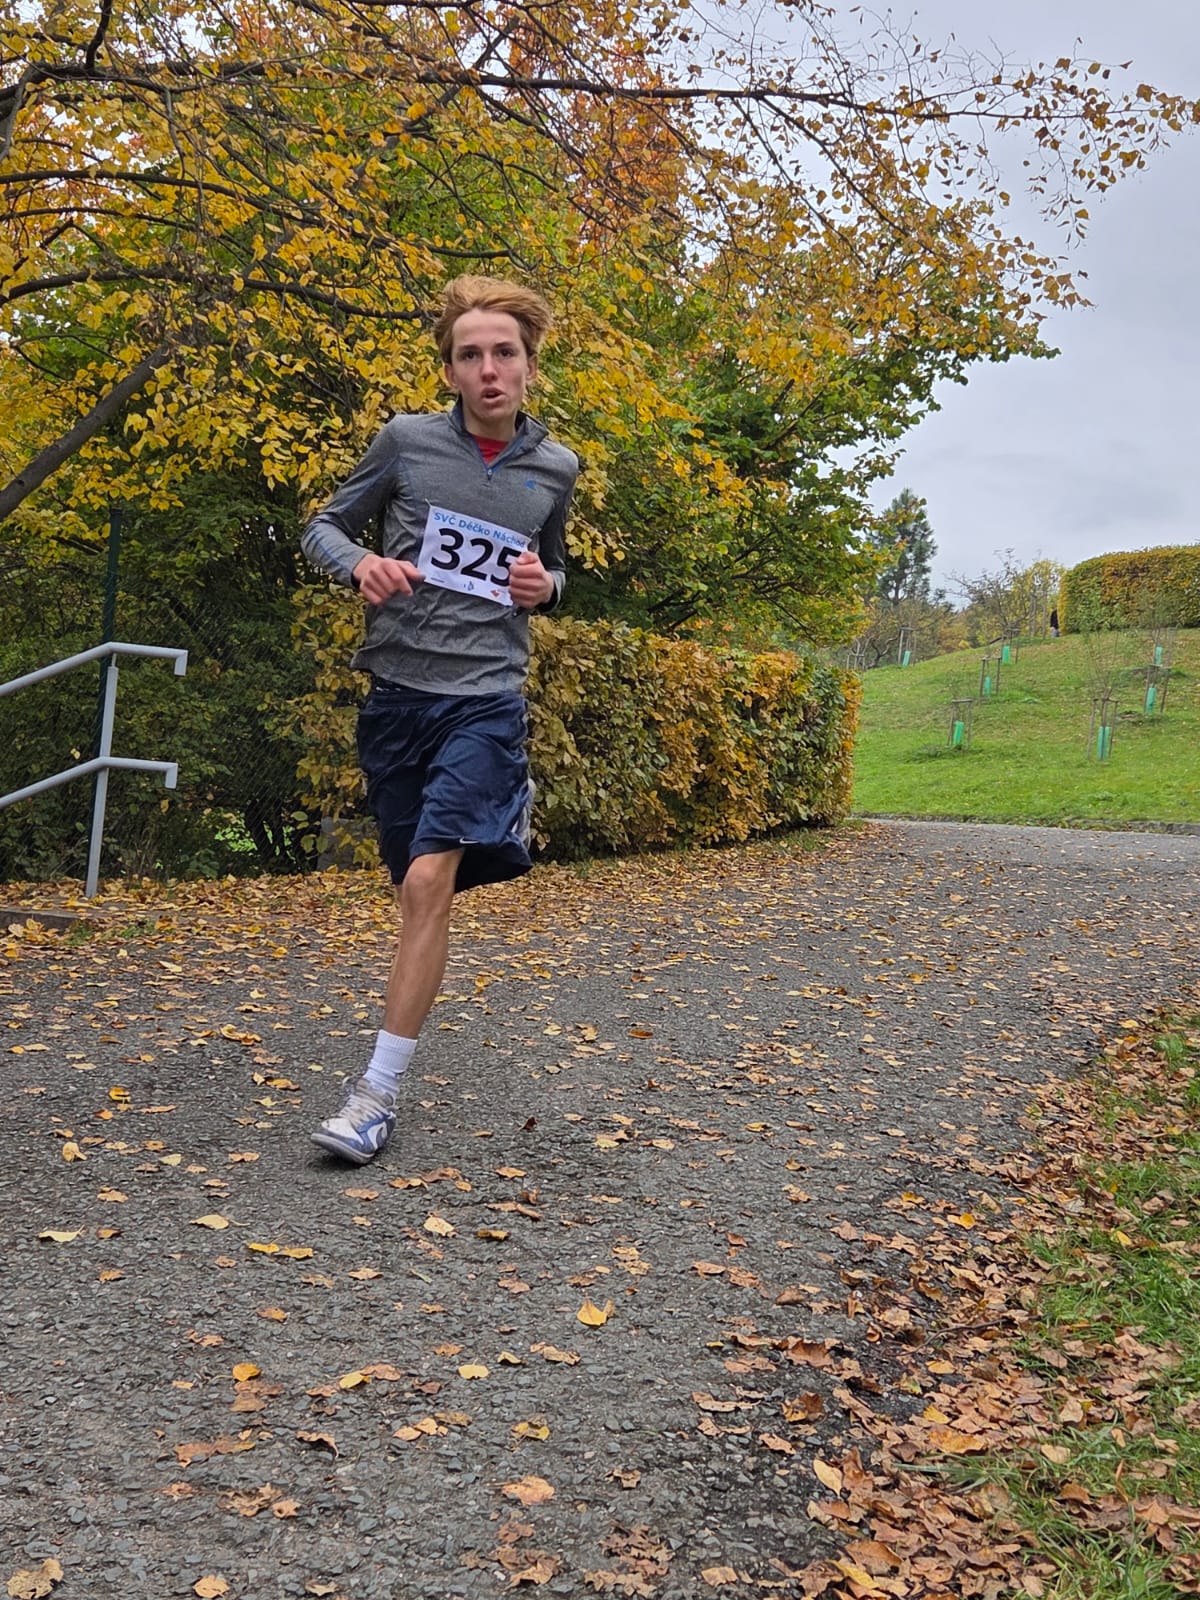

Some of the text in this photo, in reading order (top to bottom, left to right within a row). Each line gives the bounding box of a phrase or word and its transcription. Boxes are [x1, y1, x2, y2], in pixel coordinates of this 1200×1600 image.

[434, 512, 457, 526] SVČ
[458, 519, 491, 536] Déčko
[431, 528, 522, 587] 325
